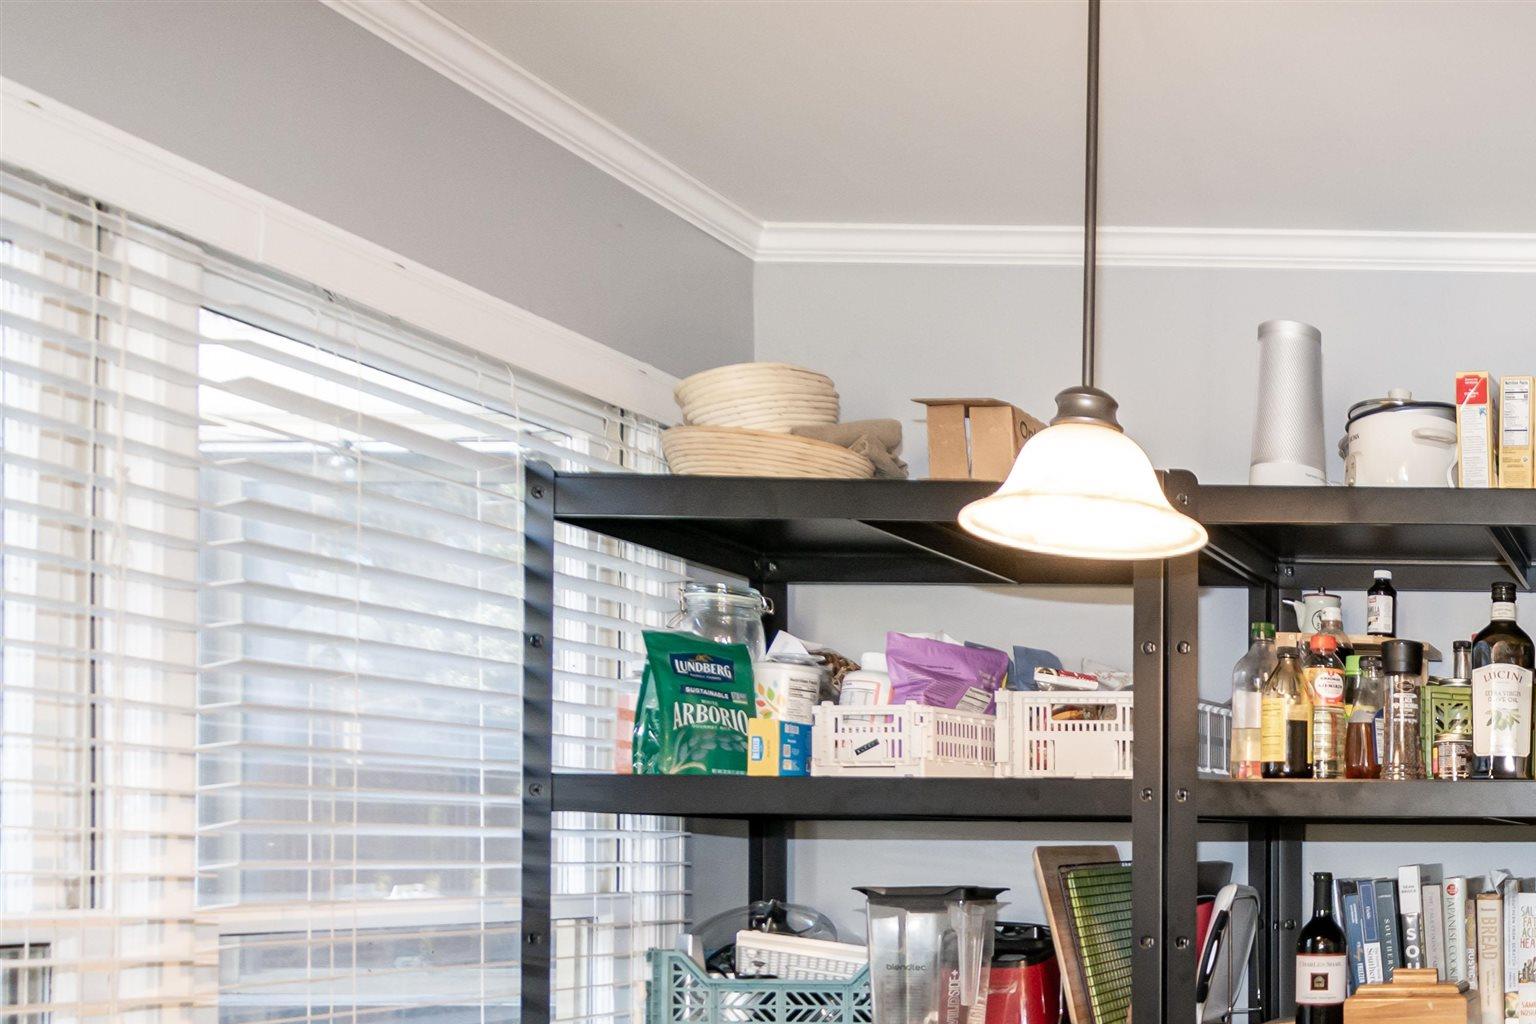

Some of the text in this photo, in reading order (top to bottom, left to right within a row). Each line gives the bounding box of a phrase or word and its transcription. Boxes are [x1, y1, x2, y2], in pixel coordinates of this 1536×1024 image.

[674, 659, 732, 679] LUNDBERG
[1483, 670, 1523, 684] LUCINI
[685, 686, 729, 700] SUSTAINABLE
[673, 701, 748, 737] ARBORIO
[1447, 898, 1457, 943] JAPANESE
[1523, 916, 1536, 926] FAT
[1481, 917, 1498, 959] BREAD
[886, 963, 927, 971] blendtec
